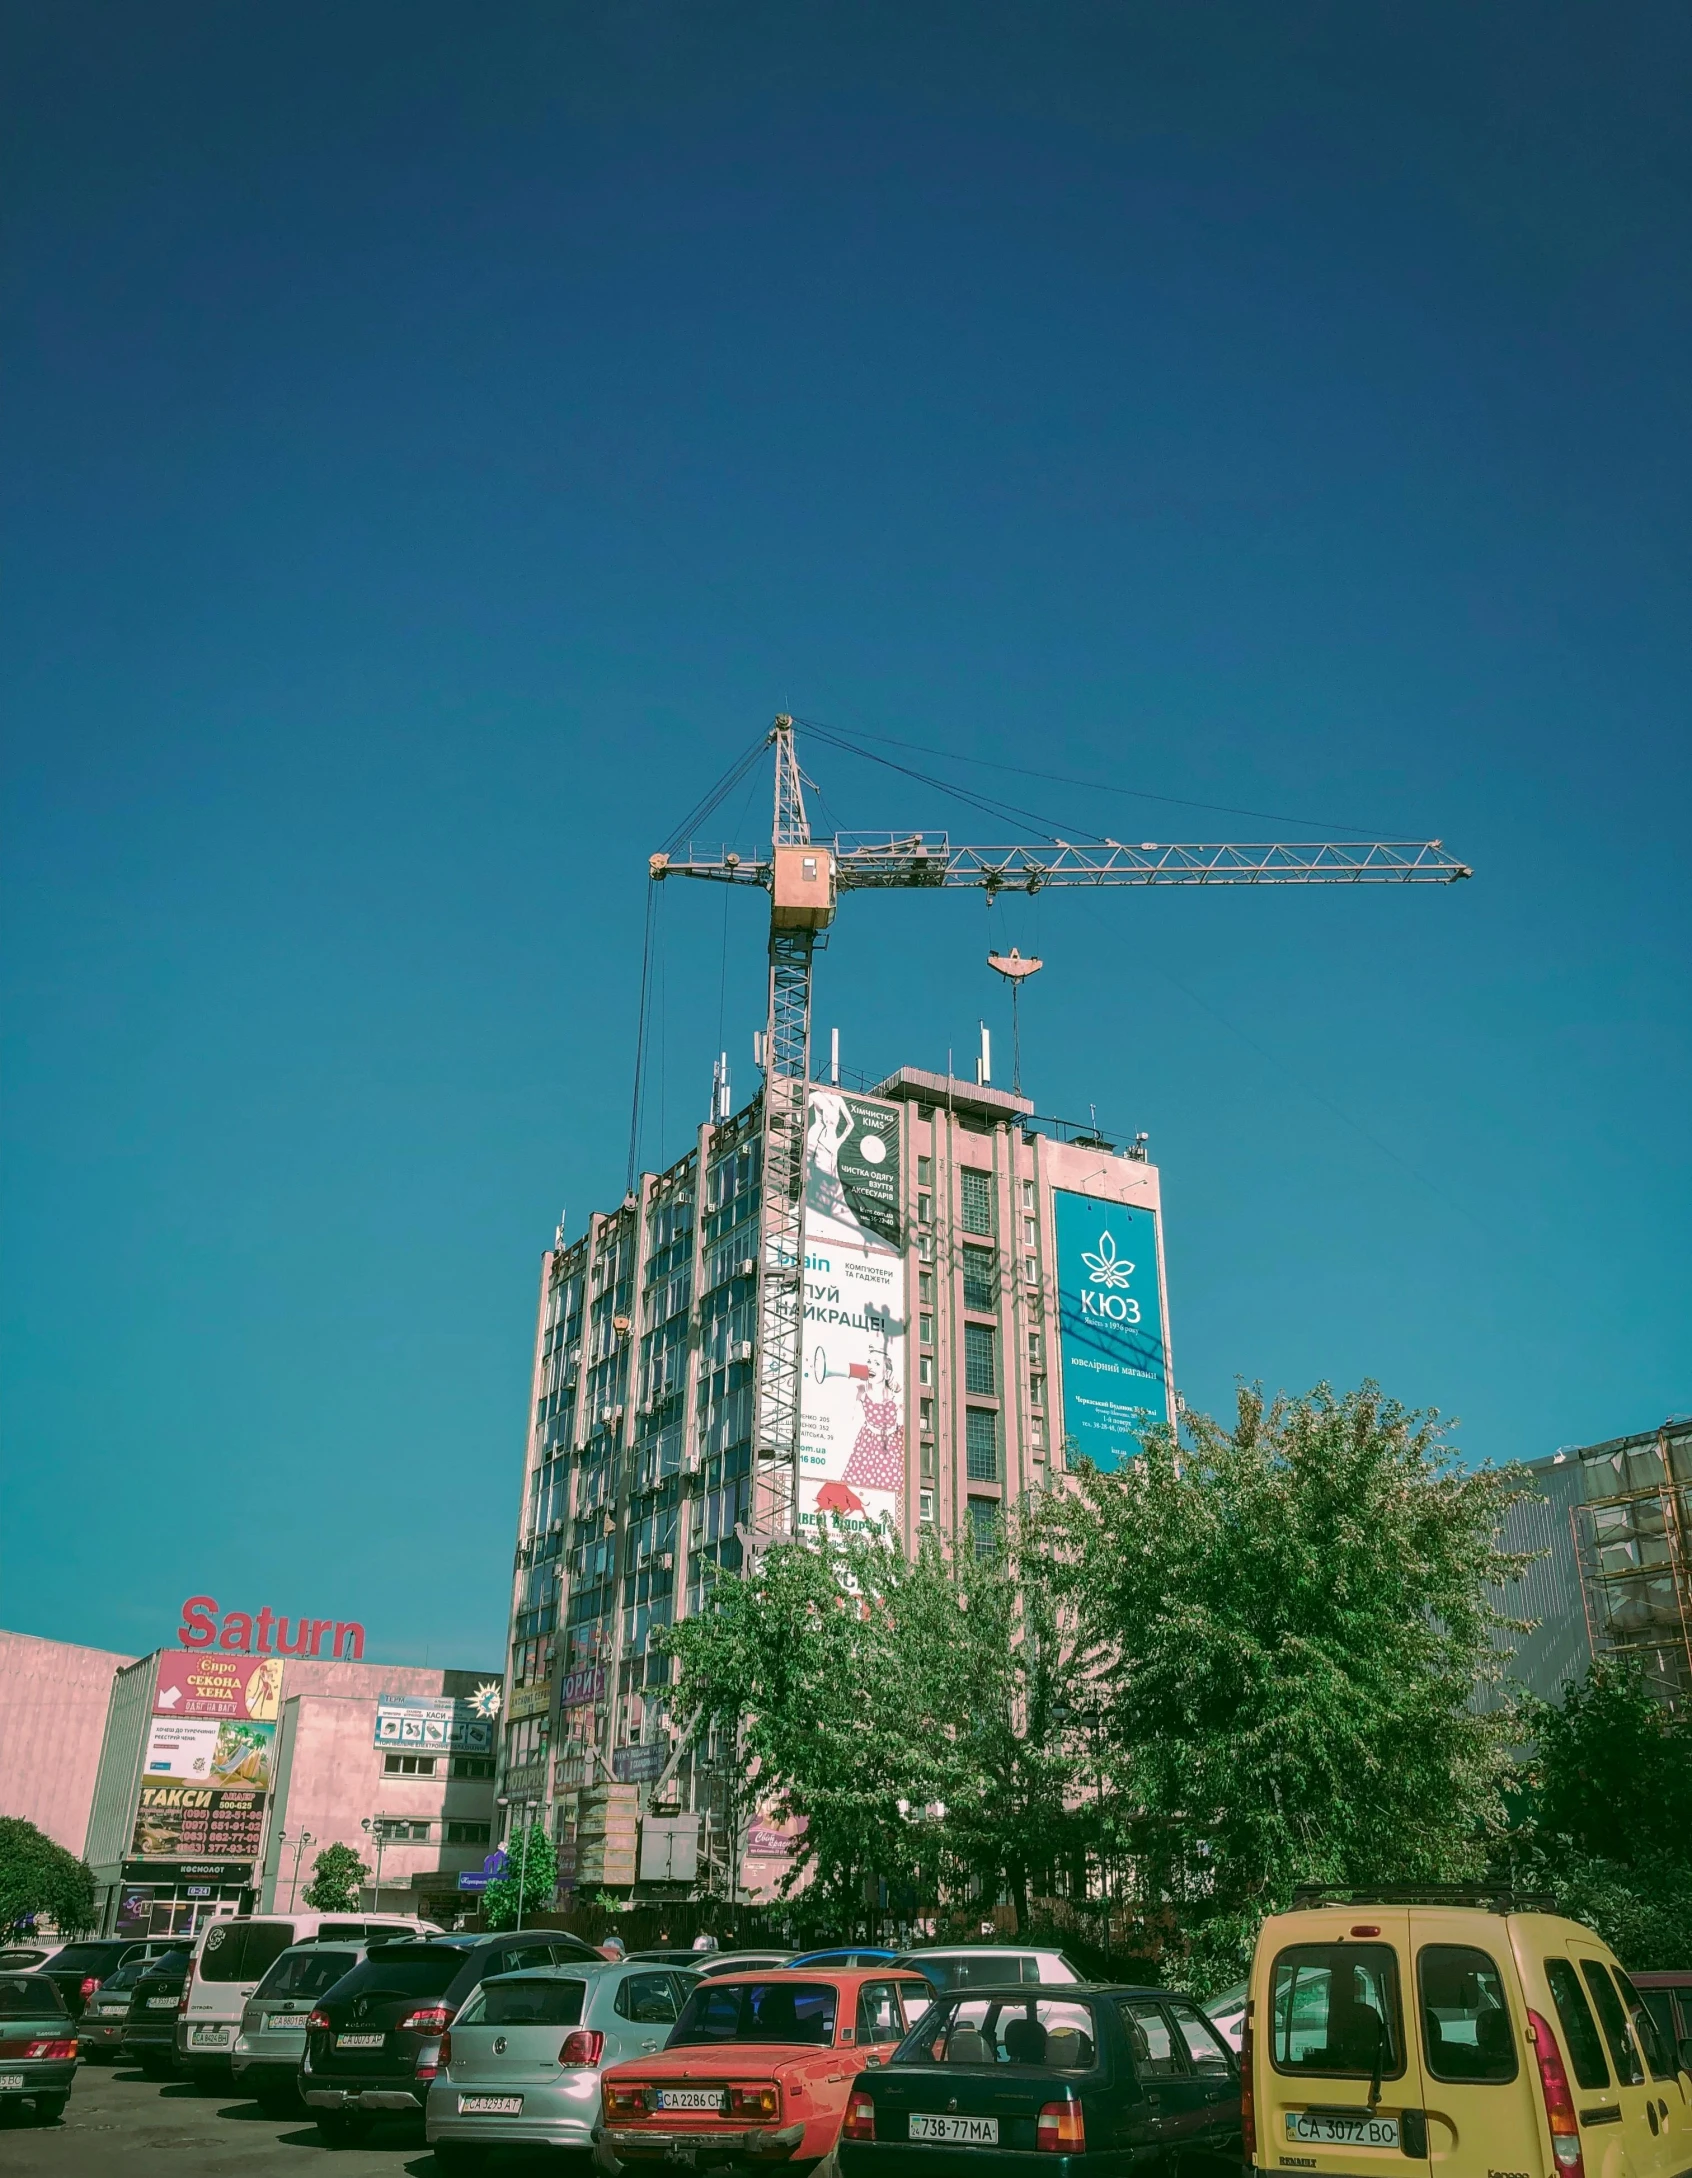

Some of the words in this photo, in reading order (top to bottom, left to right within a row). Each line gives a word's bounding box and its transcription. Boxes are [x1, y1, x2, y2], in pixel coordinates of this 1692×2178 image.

[850, 1104, 894, 1122] Хімчистка
[862, 1117, 885, 1130] KIMS
[841, 1165, 870, 1178] ЧИСТКА
[870, 1171, 894, 1182] ОДЯГУ
[868, 1180, 894, 1192] ВЗУТТЯ
[851, 1186, 894, 1201] АКСЕСУАРІВ
[855, 1272, 890, 1284] ГАДЖЕТИ
[1081, 1289, 1141, 1323] КЮЗ
[776, 1300, 885, 1333] НАЙКРАЩЕ!
[1109, 1321, 1124, 1331] 1936
[1071, 1357, 1119, 1373] ювелірний
[1122, 1366, 1157, 1379] магазин
[1076, 1395, 1108, 1408] Черкаський
[1112, 1417, 1132, 1427] поверх
[810, 1456, 826, 1465] 800
[178, 1595, 366, 1660] Saturn
[201, 1660, 237, 1674] Євро
[187, 1674, 242, 1689] СЕКОНД
[195, 1687, 233, 1700] ХЕНД
[185, 1702, 204, 1711] ОДЯГ
[206, 1703, 217, 1711] НА
[218, 1703, 237, 1713] ВАГУ
[426, 1711, 446, 1719] КАСИ
[555, 1758, 606, 1787] ОЦІНА
[142, 1789, 213, 1808] ТАКСИ
[183, 1809, 210, 1819] (095)
[181, 1820, 208, 1831] (097)
[210, 1821, 261, 1831] 651-91-02
[273, 2017, 282, 2025] CA
[342, 2035, 352, 2045] CA
[371, 2034, 383, 2044] AP
[7, 2075, 21, 2085] BC
[469, 2099, 482, 2110] CA
[505, 2099, 519, 2110] AT
[664, 2094, 679, 2106] CA
[681, 2094, 706, 2107] 2286
[707, 2094, 724, 2107] CH
[911, 2127, 920, 2136] 24
[921, 2117, 993, 2141] 738-77MA
[1297, 2118, 1321, 2139] CA
[1325, 2119, 1365, 2141] 3072
[1369, 2123, 1394, 2142] BO
[1279, 2156, 1317, 2168] RENAULT
